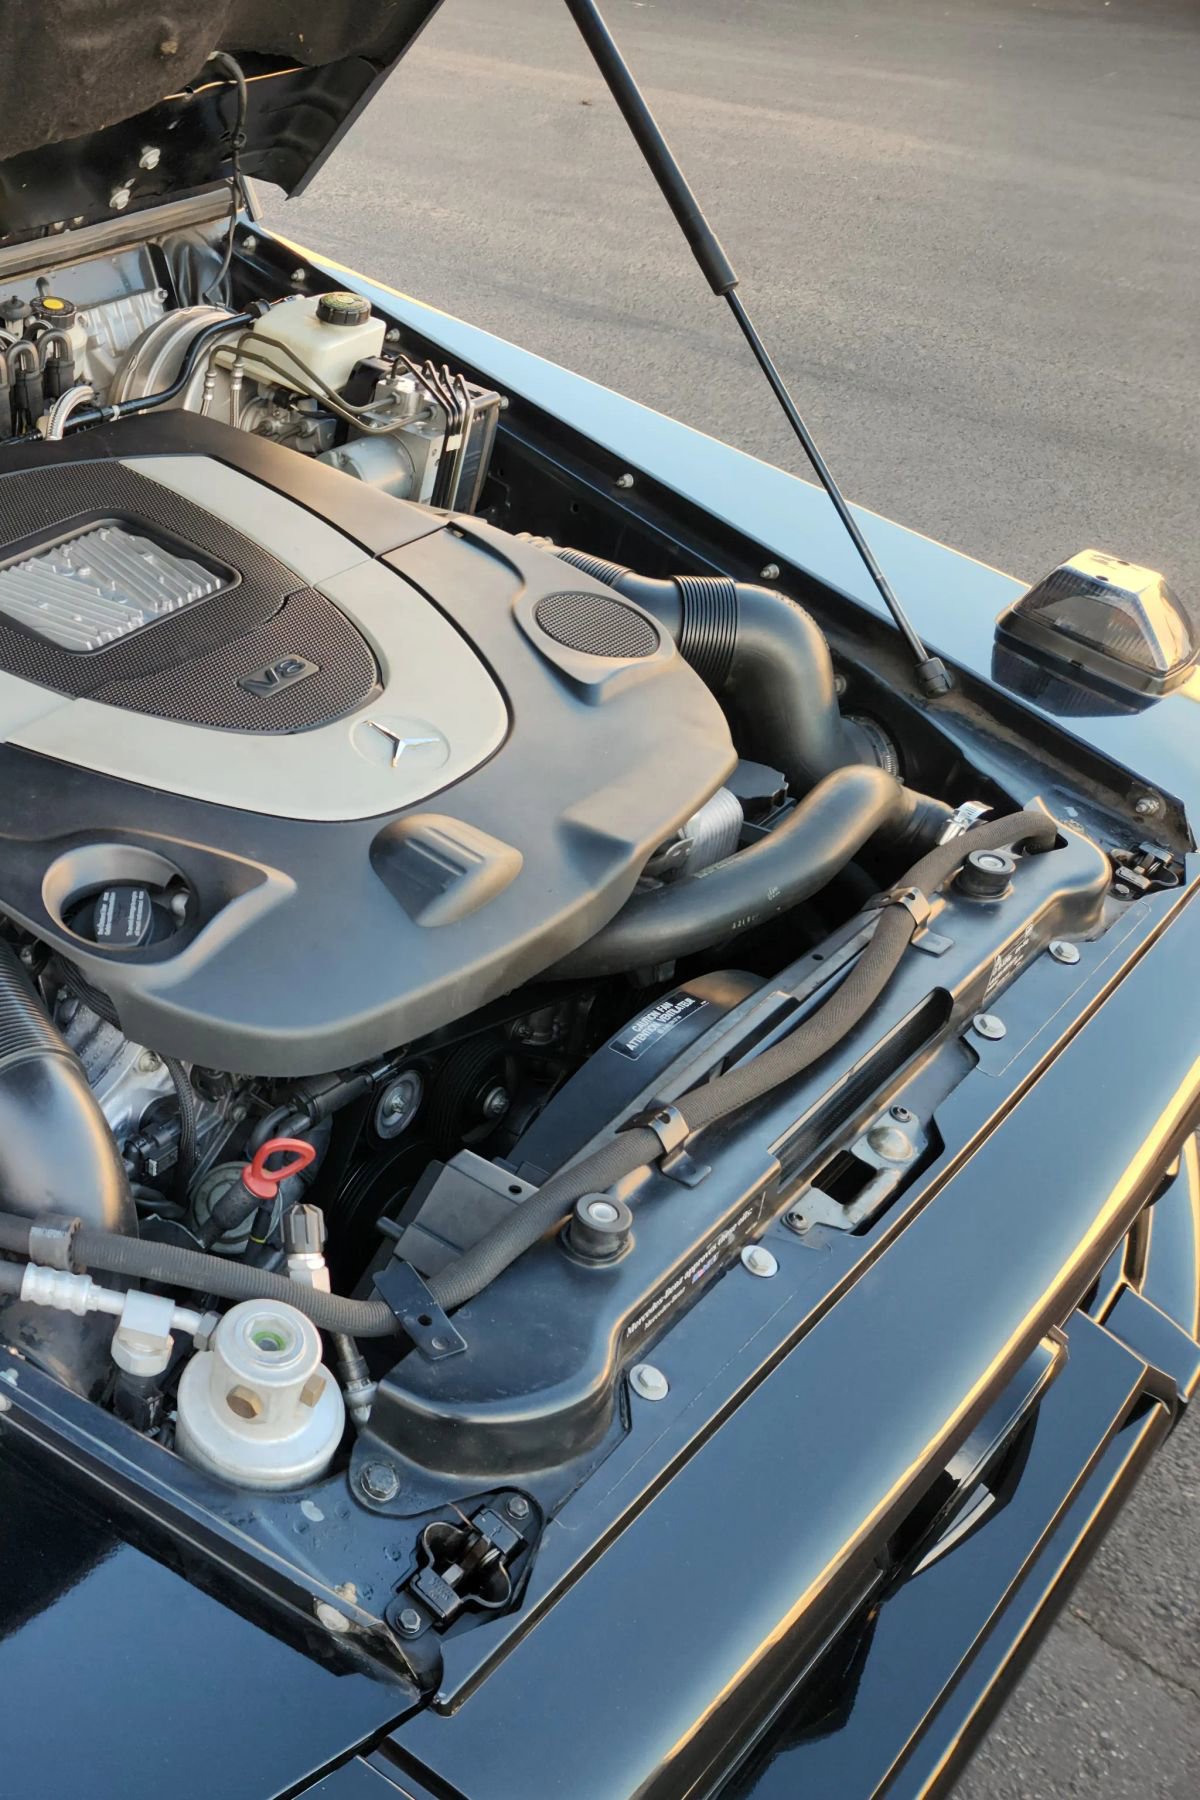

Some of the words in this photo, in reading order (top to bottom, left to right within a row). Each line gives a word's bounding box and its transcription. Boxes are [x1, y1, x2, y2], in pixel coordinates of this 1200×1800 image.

[243, 658, 307, 689] V8
[625, 1020, 662, 1051] ATTENTION
[656, 997, 696, 1023] VENTILATEUR
[631, 1009, 661, 1032] CAUTION
[655, 1001, 674, 1013] FAN
[626, 1275, 684, 1338] Mercedes-Benz
[683, 1243, 717, 1280] approves
